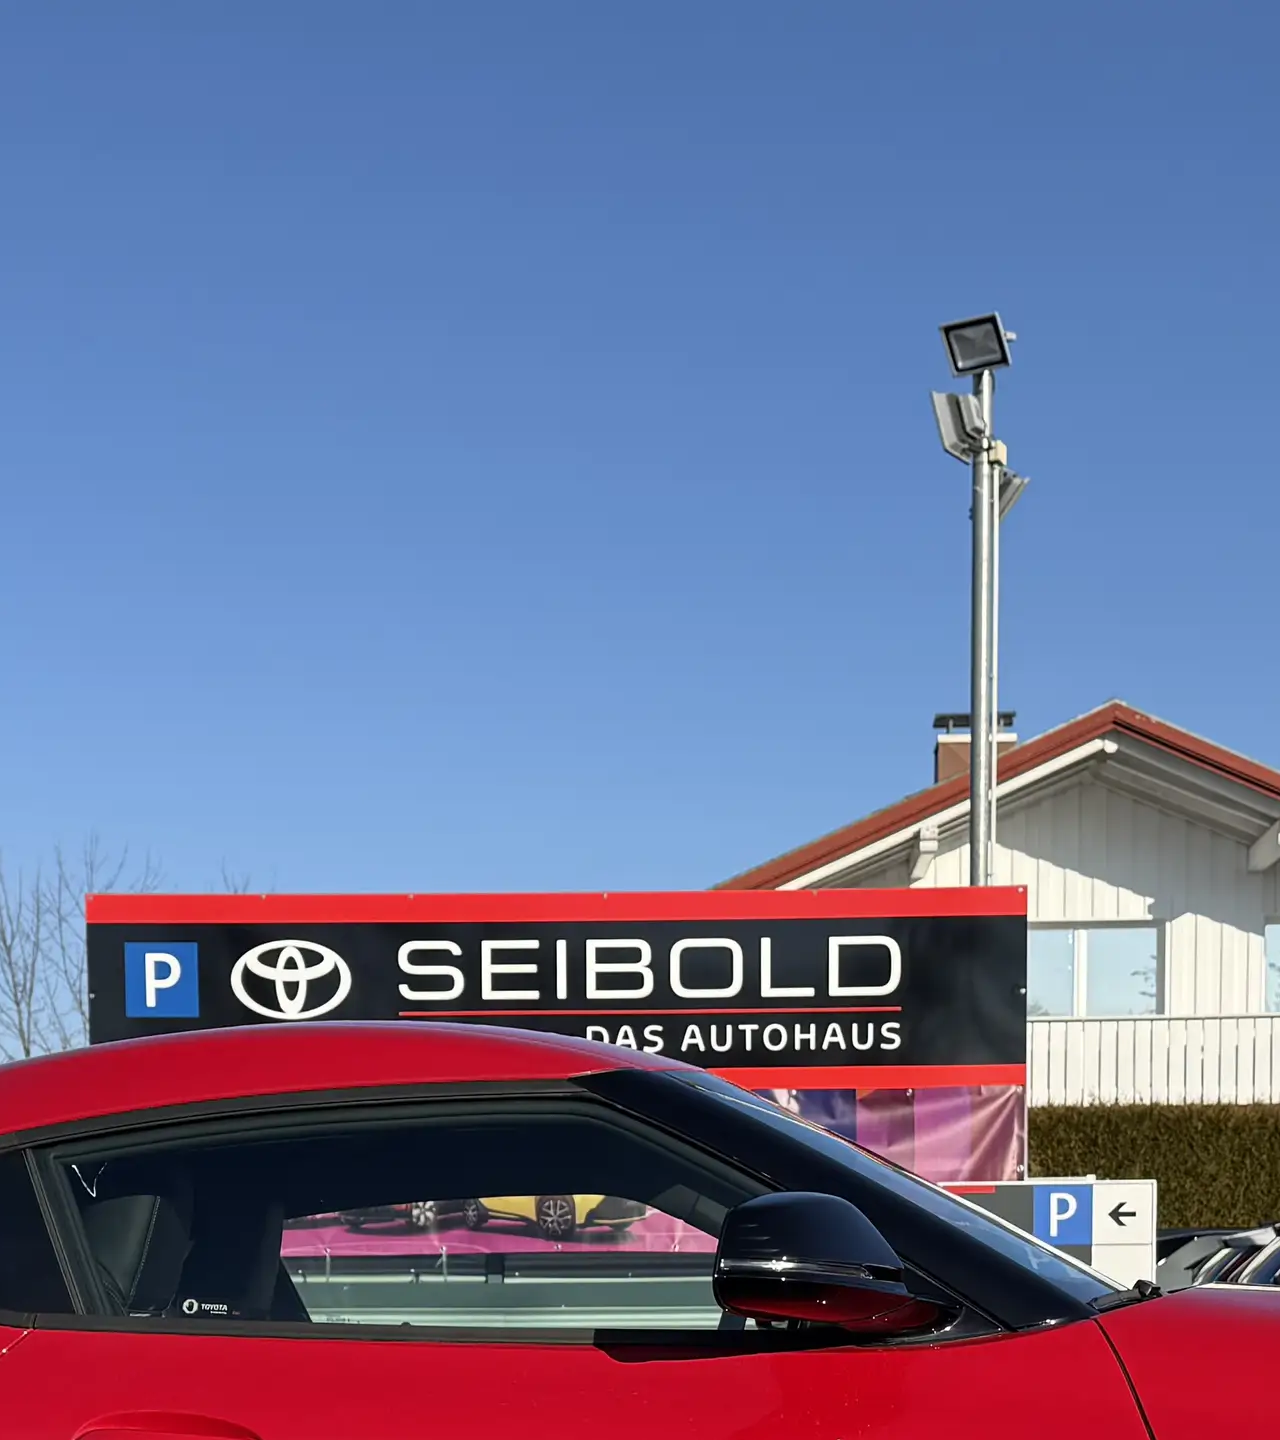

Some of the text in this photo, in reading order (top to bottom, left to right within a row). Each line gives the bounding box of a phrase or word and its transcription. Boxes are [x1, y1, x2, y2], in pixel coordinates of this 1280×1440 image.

[145, 952, 182, 1008] P
[397, 935, 903, 1001] SEIBOLD
[585, 1021, 903, 1054] DAS AUTOHAUS
[1049, 1192, 1078, 1238] P
[201, 1303, 228, 1311] TOYOTA
